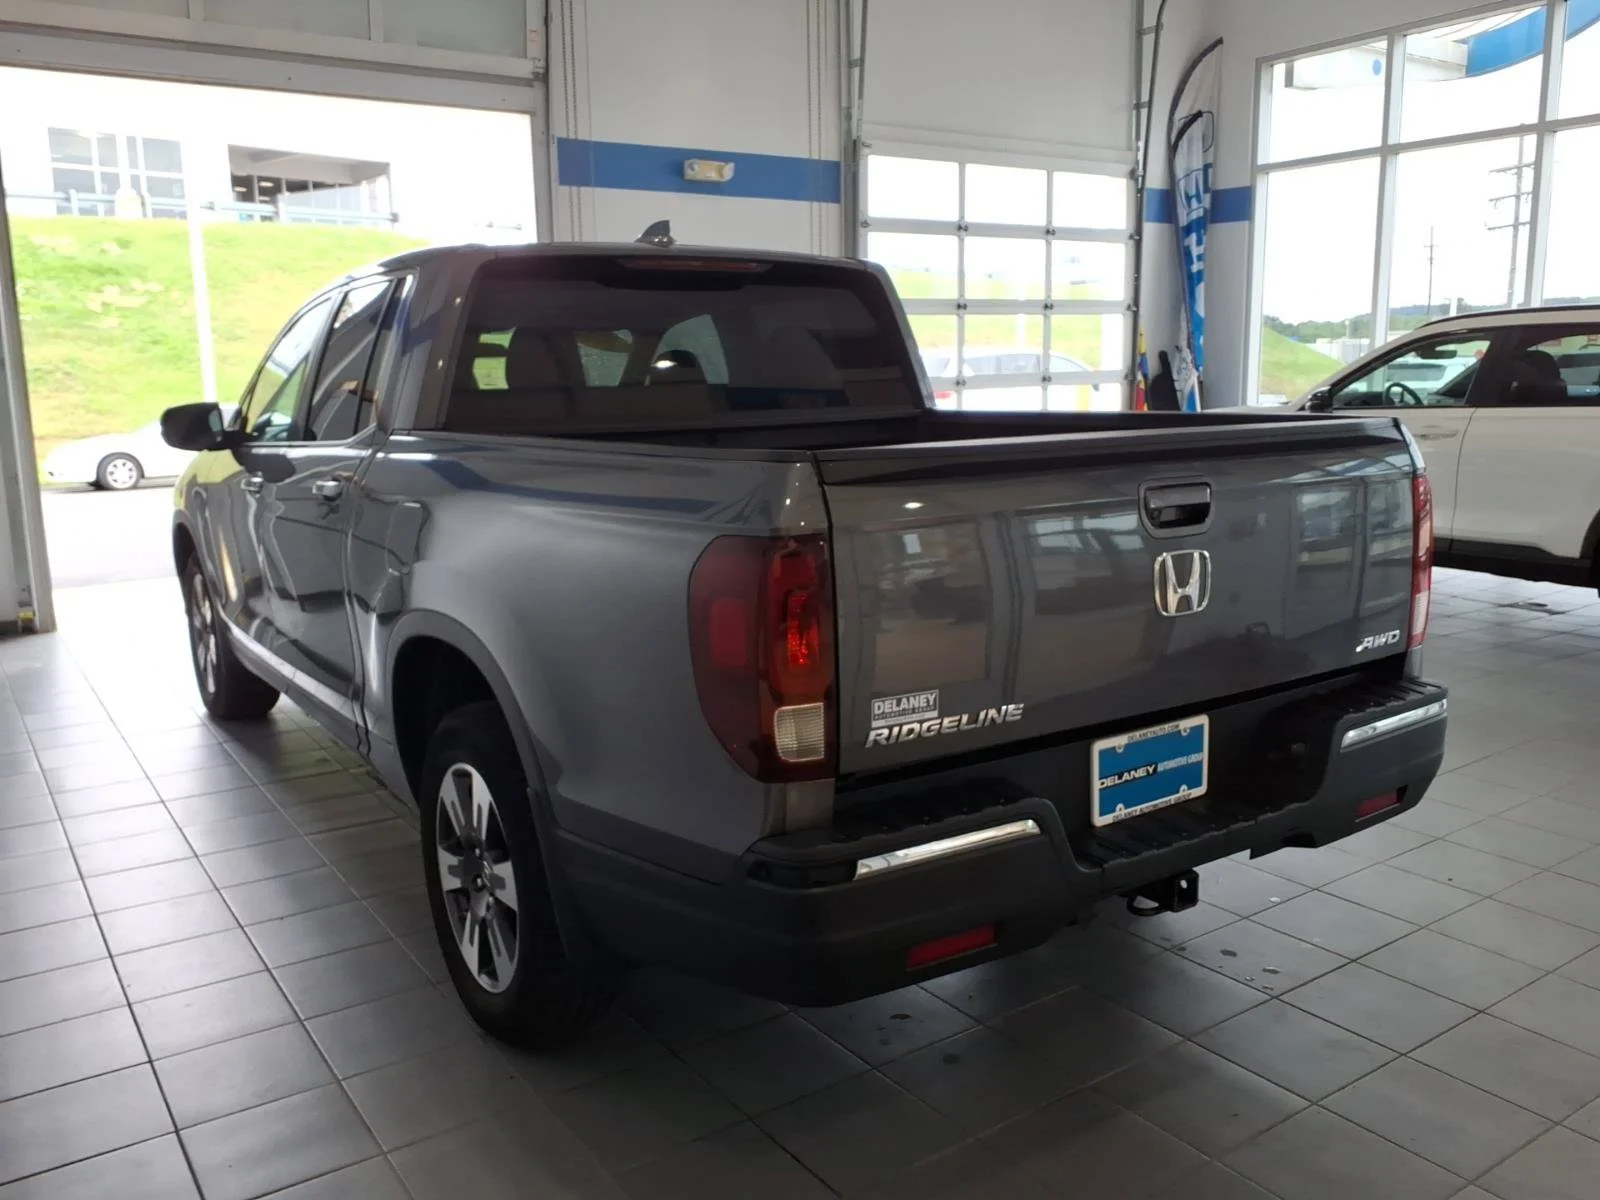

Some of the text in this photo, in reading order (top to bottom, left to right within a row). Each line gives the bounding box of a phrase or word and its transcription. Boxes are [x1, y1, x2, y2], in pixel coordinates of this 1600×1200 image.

[1355, 629, 1400, 652] AWD
[874, 692, 936, 715] DELANEY
[865, 703, 1025, 749] RIDGELINE
[1098, 764, 1156, 789] DELANEY
